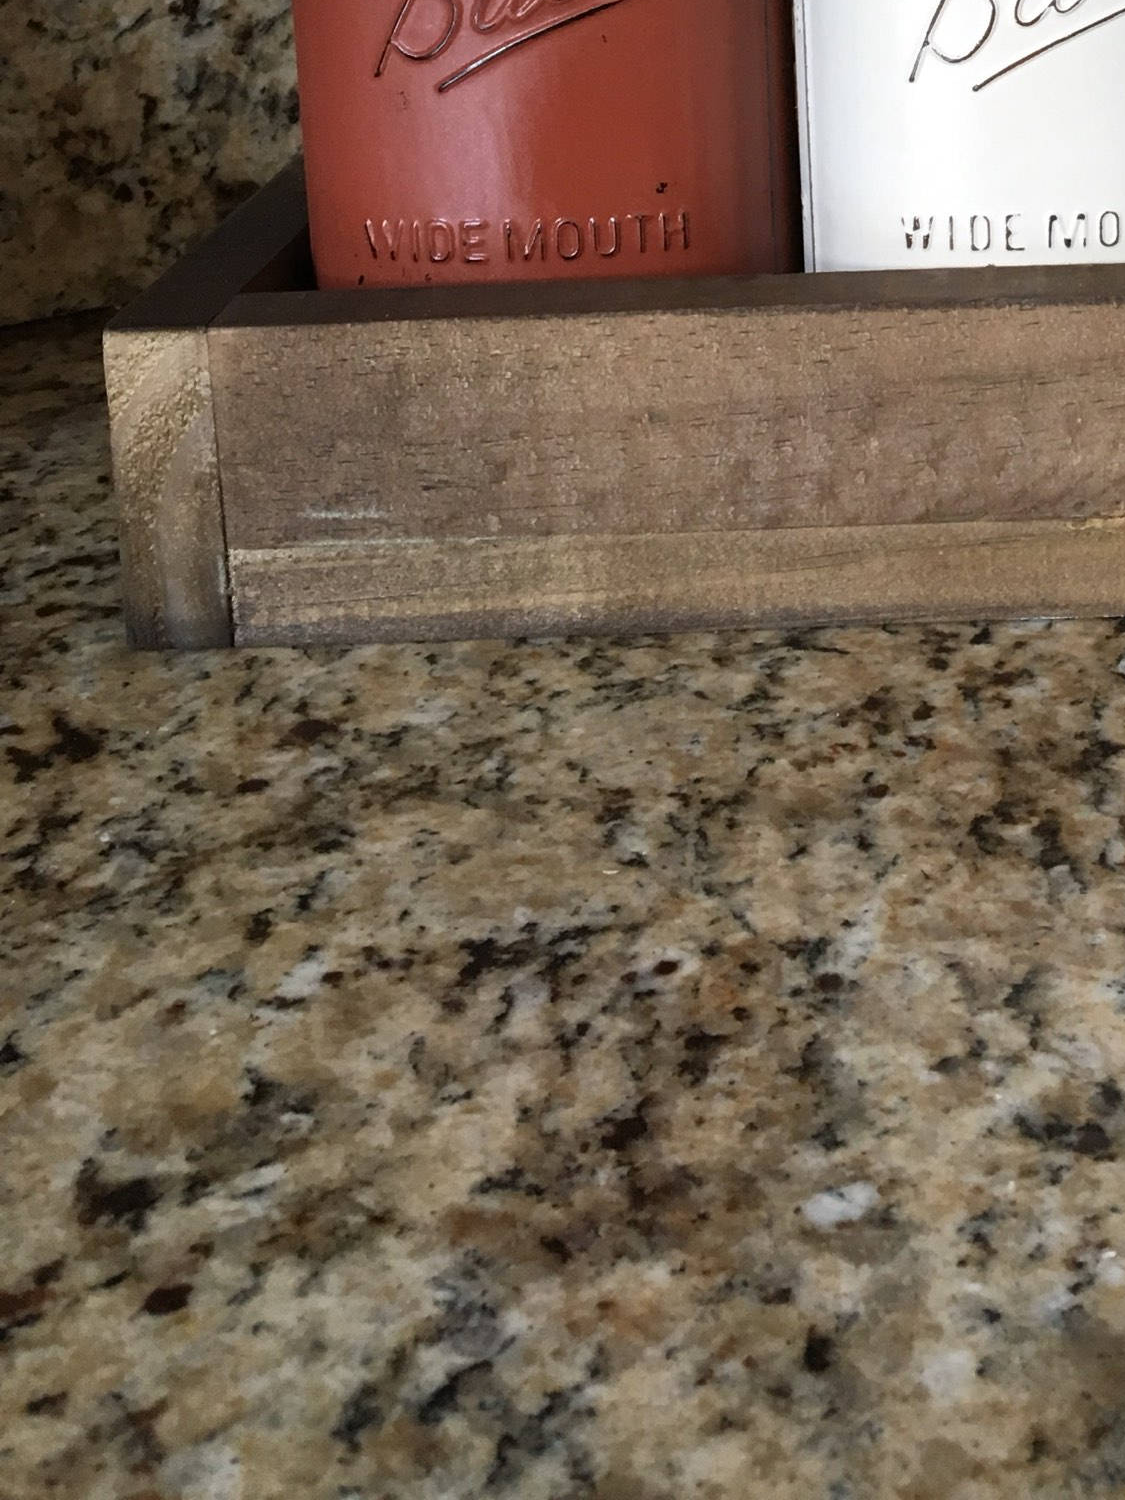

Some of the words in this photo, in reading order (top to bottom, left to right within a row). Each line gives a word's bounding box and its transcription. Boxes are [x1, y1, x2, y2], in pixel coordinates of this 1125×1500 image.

[364, 216, 491, 264] WIDE
[502, 209, 693, 263] MOUTH
[901, 213, 1026, 252] WIDE
